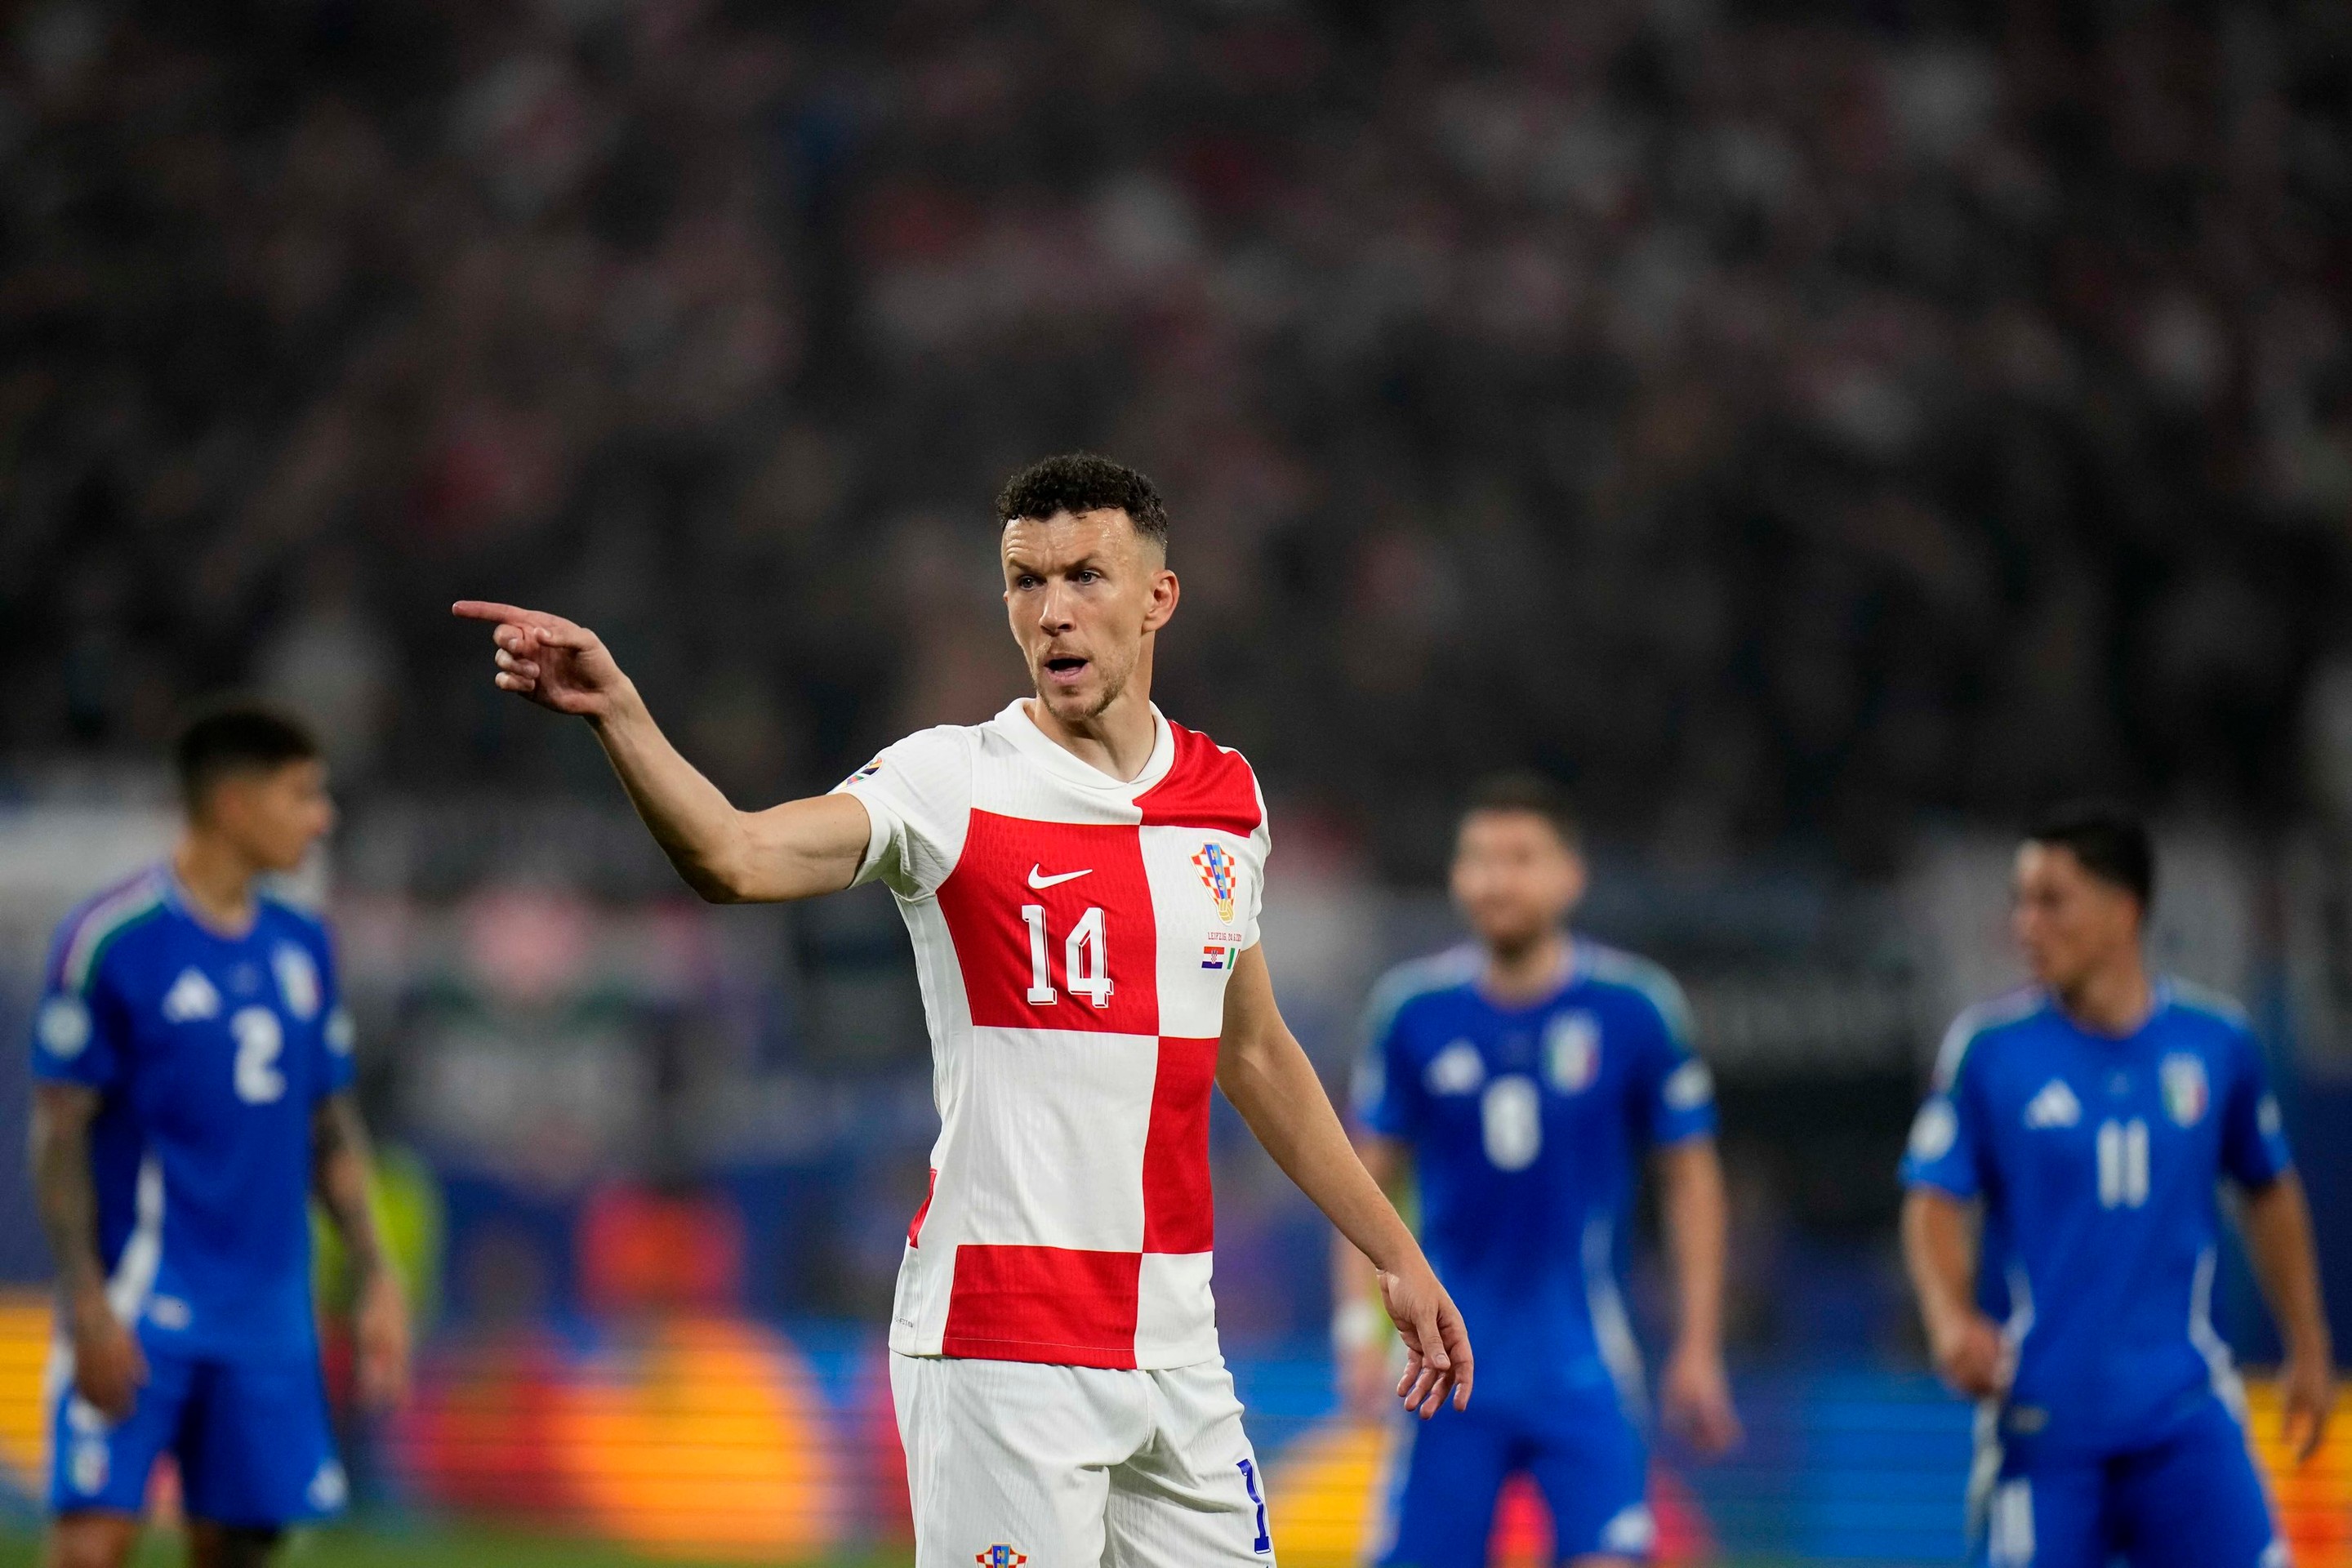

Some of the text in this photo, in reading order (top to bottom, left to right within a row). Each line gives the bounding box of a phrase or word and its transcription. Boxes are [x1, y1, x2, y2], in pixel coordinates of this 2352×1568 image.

[1022, 904, 1114, 1009] 14
[229, 1006, 287, 1103] 2
[2096, 1119, 2150, 1209] 11
